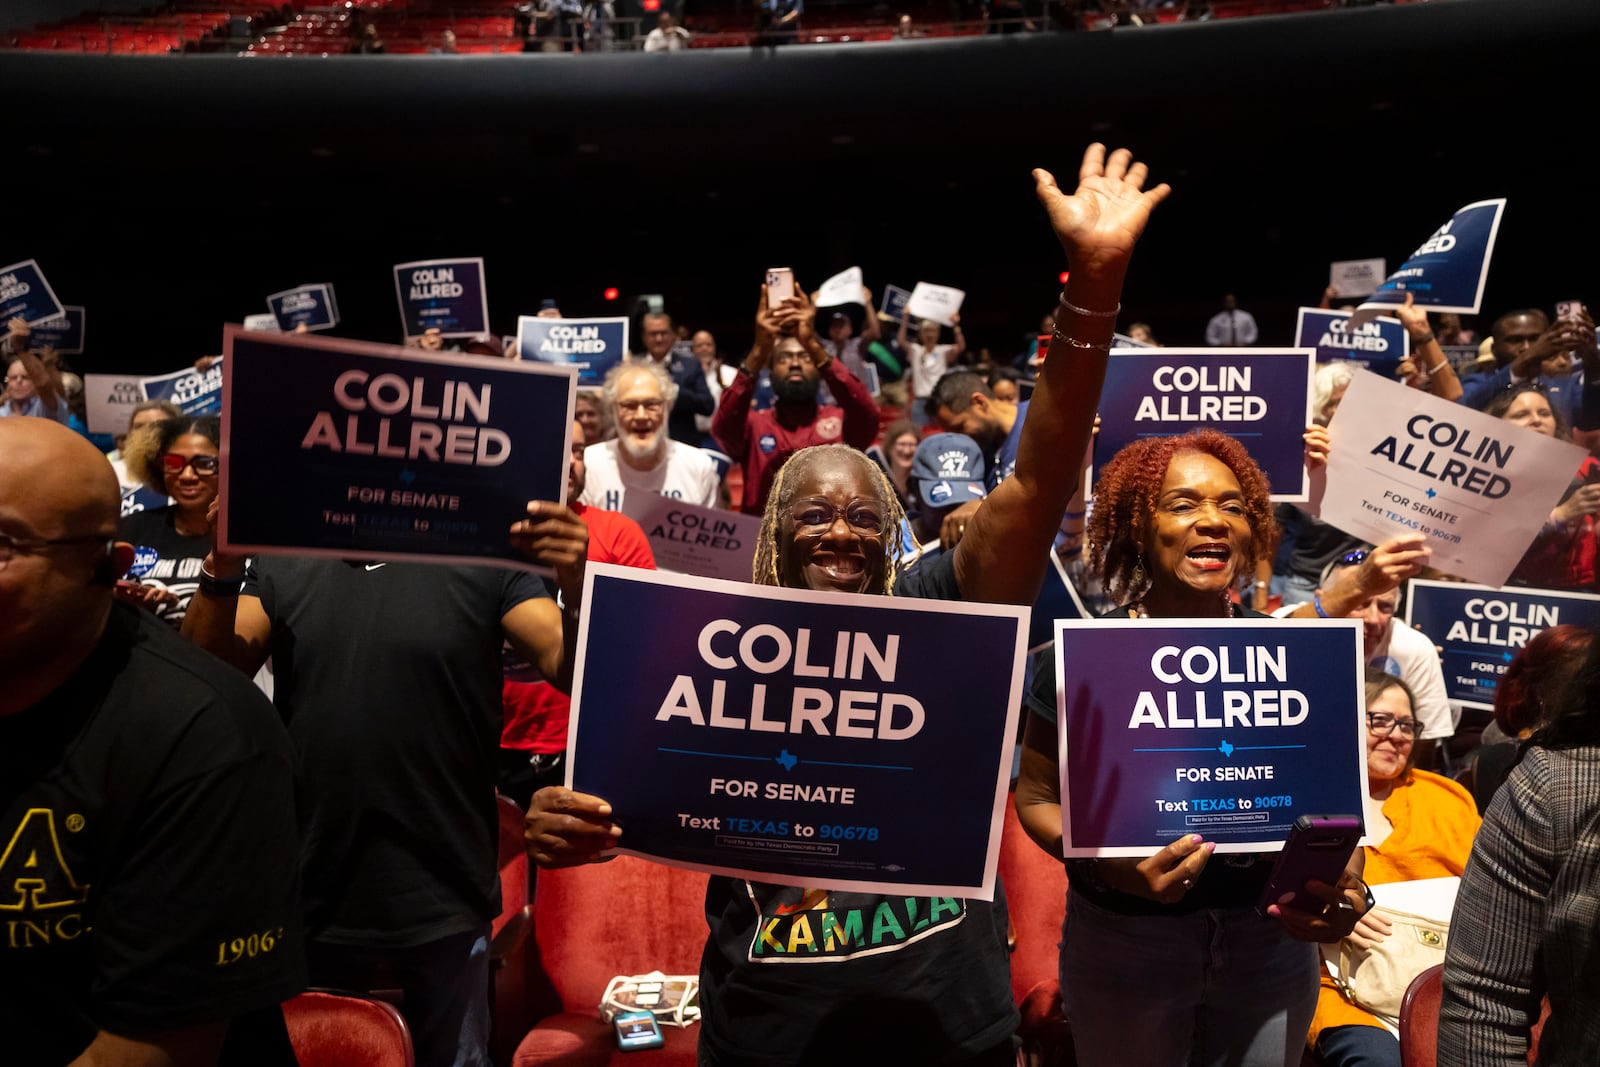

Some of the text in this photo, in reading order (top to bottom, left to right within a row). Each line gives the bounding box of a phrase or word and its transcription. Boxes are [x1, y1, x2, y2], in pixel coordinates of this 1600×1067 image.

[411, 267, 455, 286] COLIN
[409, 282, 464, 302] ALLRED
[540, 338, 607, 354] ALLRED
[549, 325, 599, 341] COLIN
[1318, 331, 1390, 353] ALLRED
[1152, 365, 1252, 393] COLIN
[333, 368, 492, 425] COLIN
[1134, 395, 1268, 422] ALLRED
[301, 410, 512, 467] ALLRED
[1406, 414, 1515, 470] COLIN
[942, 458, 966, 472] 47
[1370, 436, 1512, 500] ALLRED
[347, 485, 461, 512] FOR SENATE
[1383, 490, 1459, 525] FOR SENATE
[322, 509, 357, 526] Text
[413, 517, 430, 532] to
[667, 510, 737, 536] COLIN
[1361, 499, 1463, 545] Text TEXAS to 90678
[650, 524, 742, 551] ALLRED
[1464, 597, 1560, 628] COLIN
[1445, 620, 1543, 649] ALLR
[697, 618, 900, 684] COLIN
[1150, 645, 1288, 685] COLIN
[1470, 661, 1495, 674] FOR
[655, 674, 927, 742] ALLRED
[1128, 689, 1310, 730] ALLRED
[1176, 765, 1274, 783] FOR SENATE
[710, 778, 856, 806] FOR SENATE
[1155, 795, 1293, 812] Text TEXAS to 90678
[677, 812, 880, 843] Text TEXAS to 90678
[5, 913, 93, 948] INC.
[753, 896, 962, 955] KAMALA
